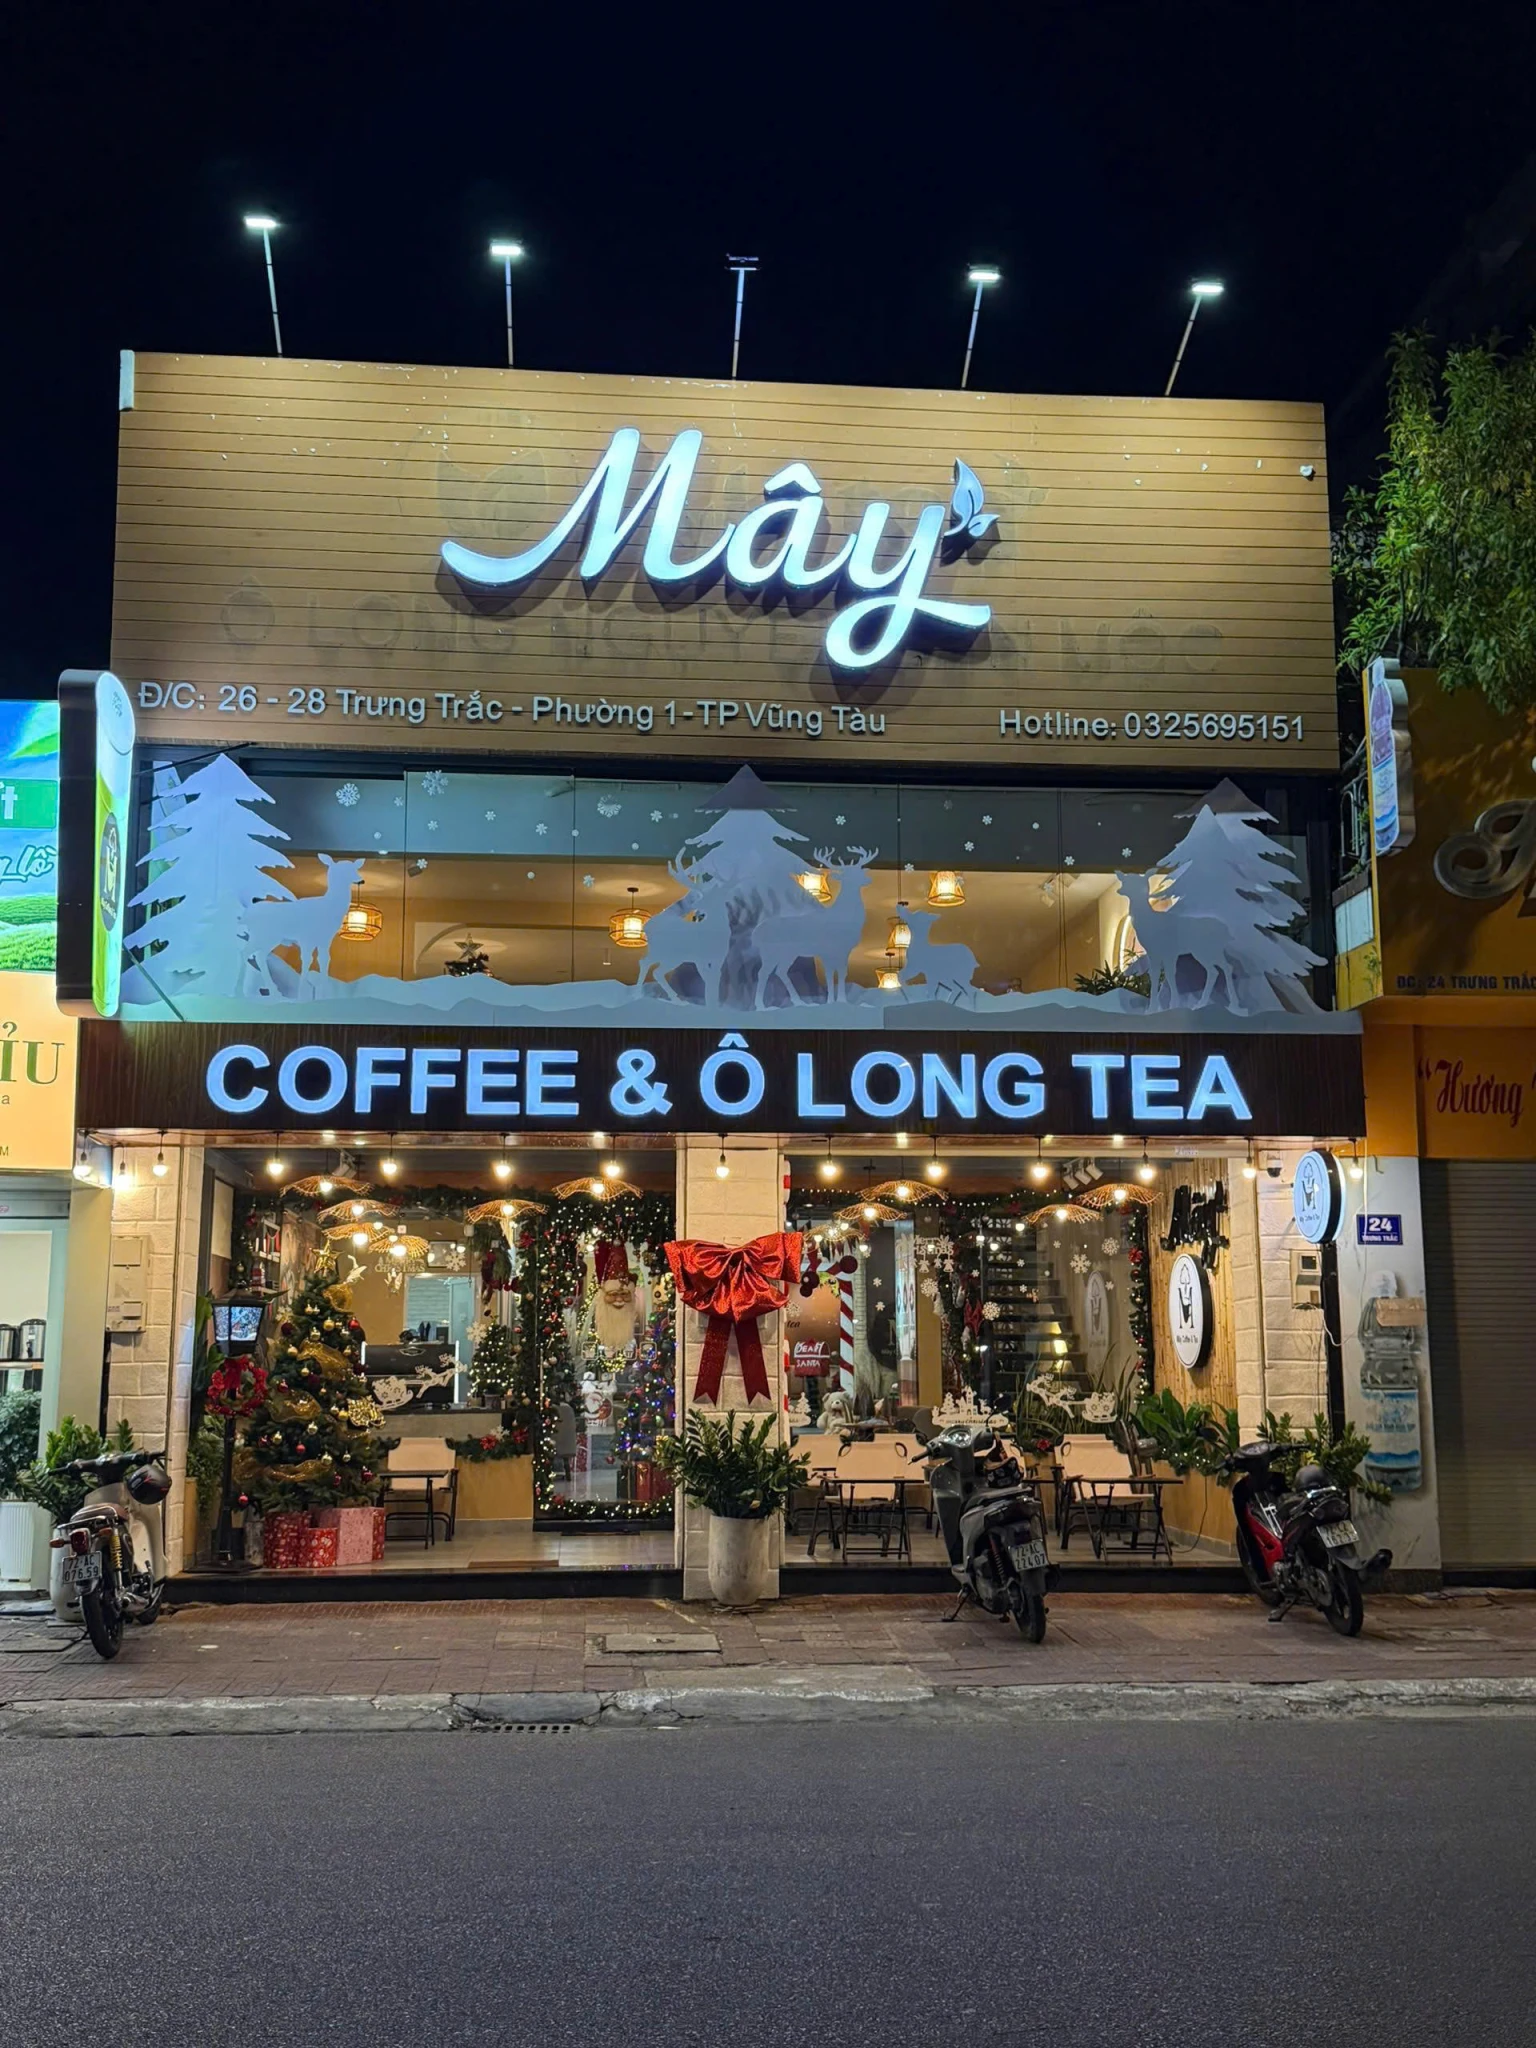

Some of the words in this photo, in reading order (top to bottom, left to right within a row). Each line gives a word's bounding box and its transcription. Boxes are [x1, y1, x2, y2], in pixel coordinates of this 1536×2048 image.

[441, 426, 992, 672] Mây
[138, 681, 205, 709] Đ/C:
[218, 685, 257, 711] 26
[287, 688, 326, 715] 28
[336, 689, 426, 724] Trưng
[435, 690, 503, 721] Trắc
[532, 695, 653, 731] Phường
[832, 705, 885, 735] Tàu
[999, 709, 1117, 738] Hotline:
[1124, 711, 1305, 742] 0325695151
[206, 1044, 580, 1117] COFFEE
[609, 1047, 673, 1117] &
[699, 1032, 766, 1117] Ô
[797, 1050, 1046, 1120] LONG
[1071, 1053, 1254, 1121] TEA
[1368, 1217, 1393, 1232] 24
